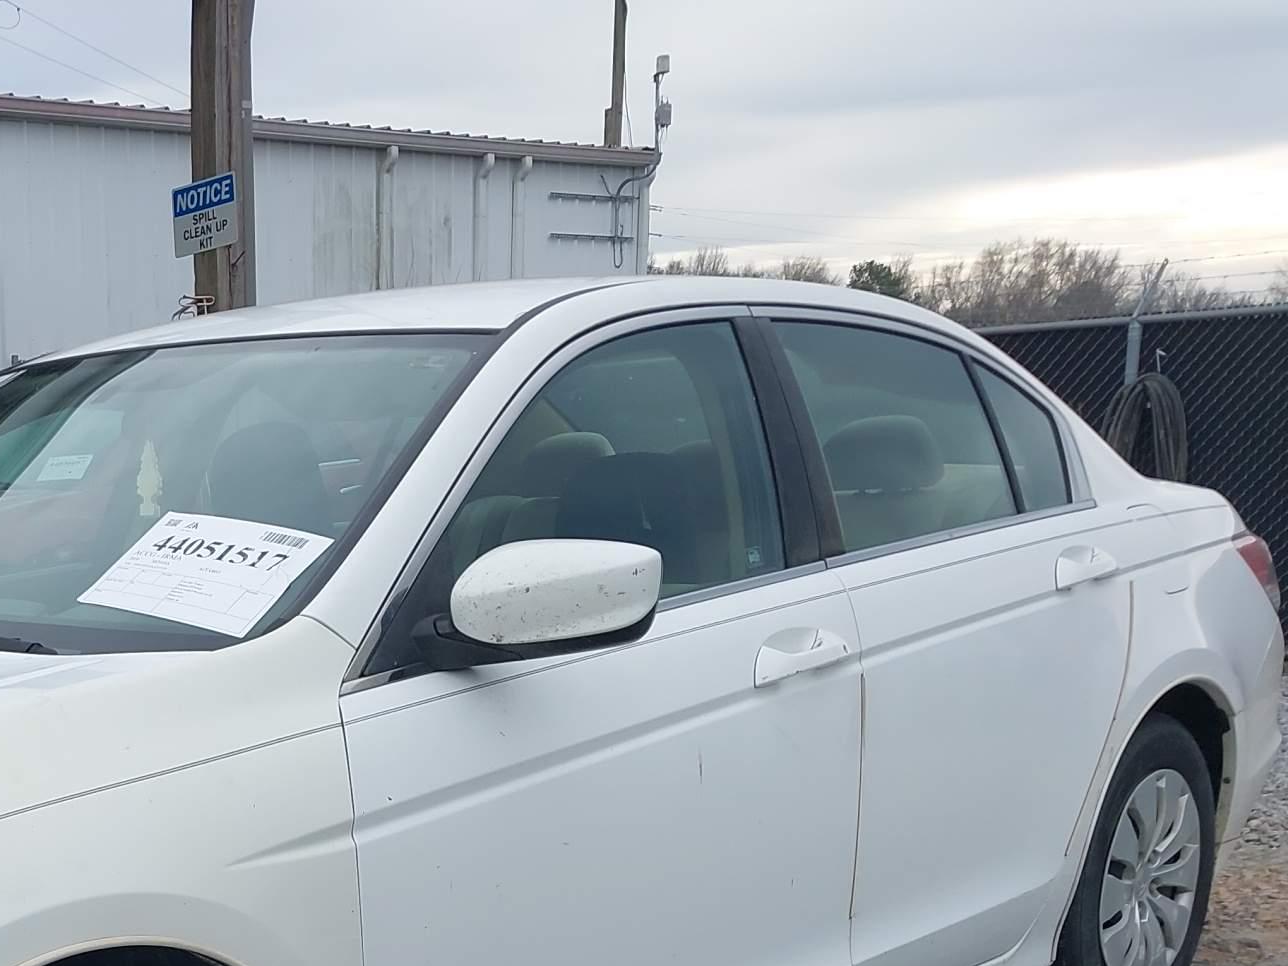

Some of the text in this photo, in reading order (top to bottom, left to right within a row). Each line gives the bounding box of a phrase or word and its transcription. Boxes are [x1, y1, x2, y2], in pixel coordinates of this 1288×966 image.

[176, 179, 231, 213] NOTICE
[192, 209, 217, 225] SPILL
[183, 219, 228, 240] CLEAN UP
[199, 236, 213, 250] KIT
[152, 535, 290, 571] 44051517
